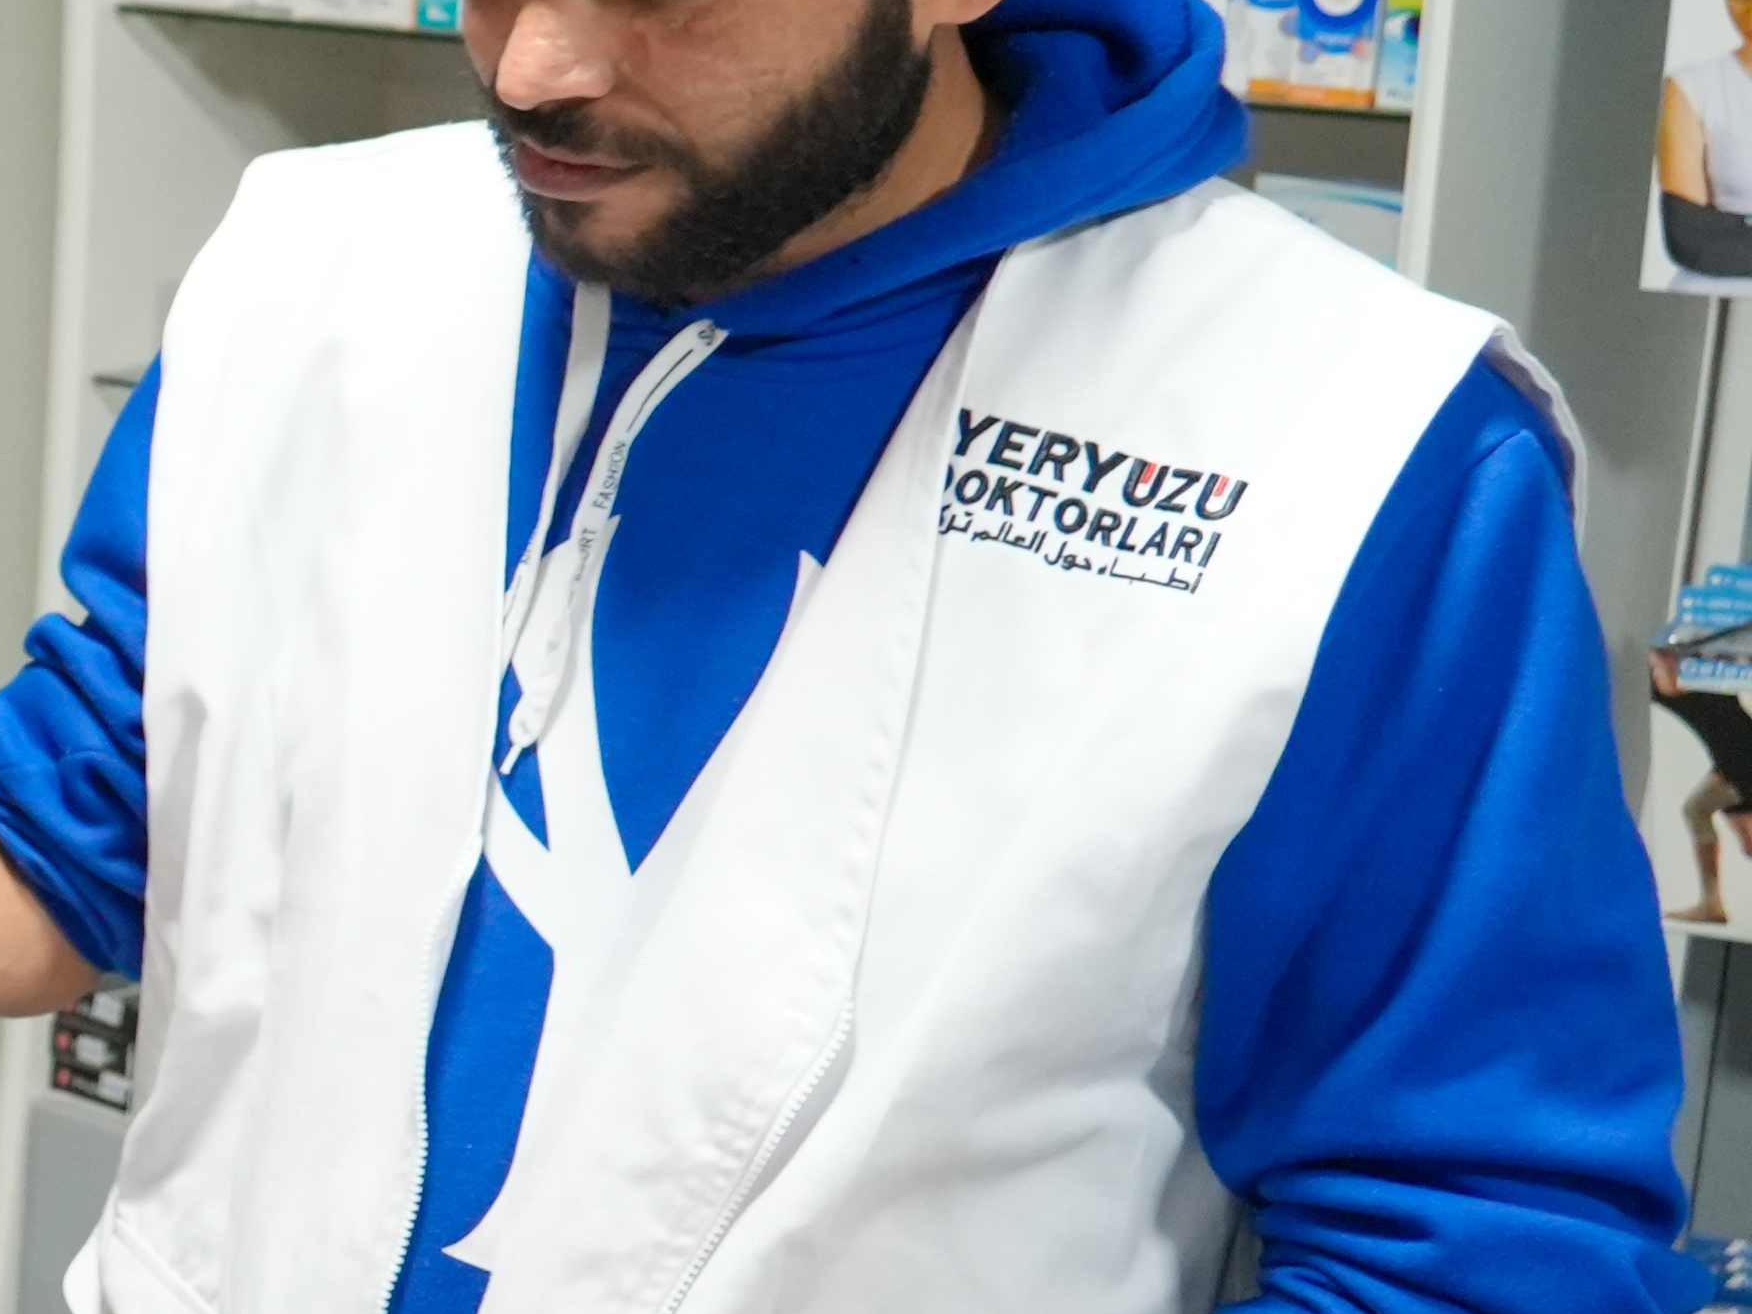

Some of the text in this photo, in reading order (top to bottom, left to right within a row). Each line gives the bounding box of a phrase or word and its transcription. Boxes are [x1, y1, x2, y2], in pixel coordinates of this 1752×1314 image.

[592, 440, 627, 509] FASHION
[971, 521, 1049, 554] العالم
[1043, 541, 1092, 572] حول
